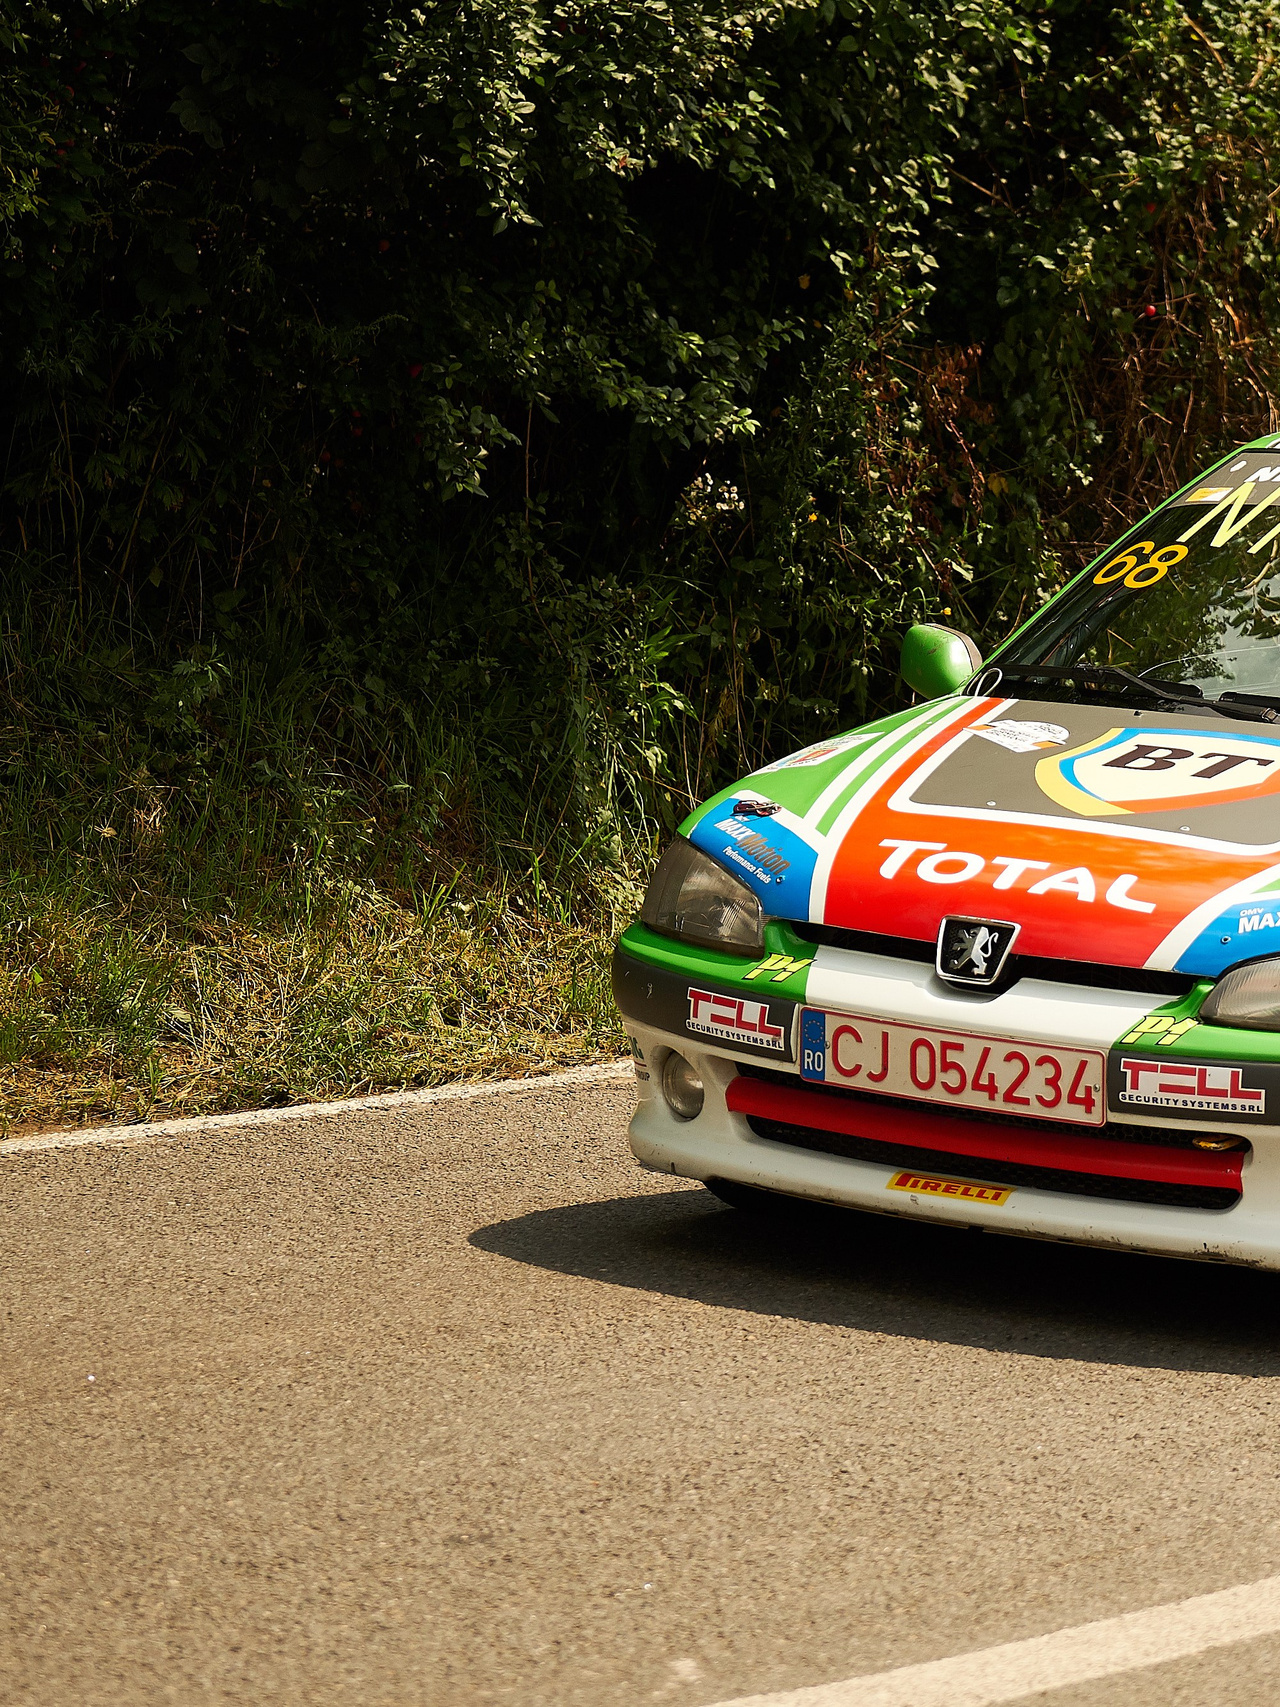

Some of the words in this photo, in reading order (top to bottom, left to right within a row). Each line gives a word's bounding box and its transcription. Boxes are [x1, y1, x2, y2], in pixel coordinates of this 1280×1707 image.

[1093, 541, 1189, 589] 68
[1101, 744, 1275, 779] BT
[722, 846, 757, 872] Performance
[753, 867, 772, 884] Fuels
[878, 838, 1157, 914] TOTAL
[1240, 908, 1264, 916] OMV
[687, 988, 783, 1037] TELL
[686, 1020, 724, 1037] SECURITY
[725, 1029, 764, 1046] SYSTEMS
[765, 1039, 783, 1049] SRL
[804, 1049, 824, 1073] RO
[831, 1024, 889, 1083] CJ
[909, 1037, 1095, 1114] 054234
[1122, 1061, 1262, 1100] TELL
[1120, 1093, 1179, 1107] SECURITY
[1181, 1099, 1237, 1111] SYSTEMS
[1240, 1104, 1262, 1113] SRL
[892, 1171, 1012, 1202] PIRELLI
